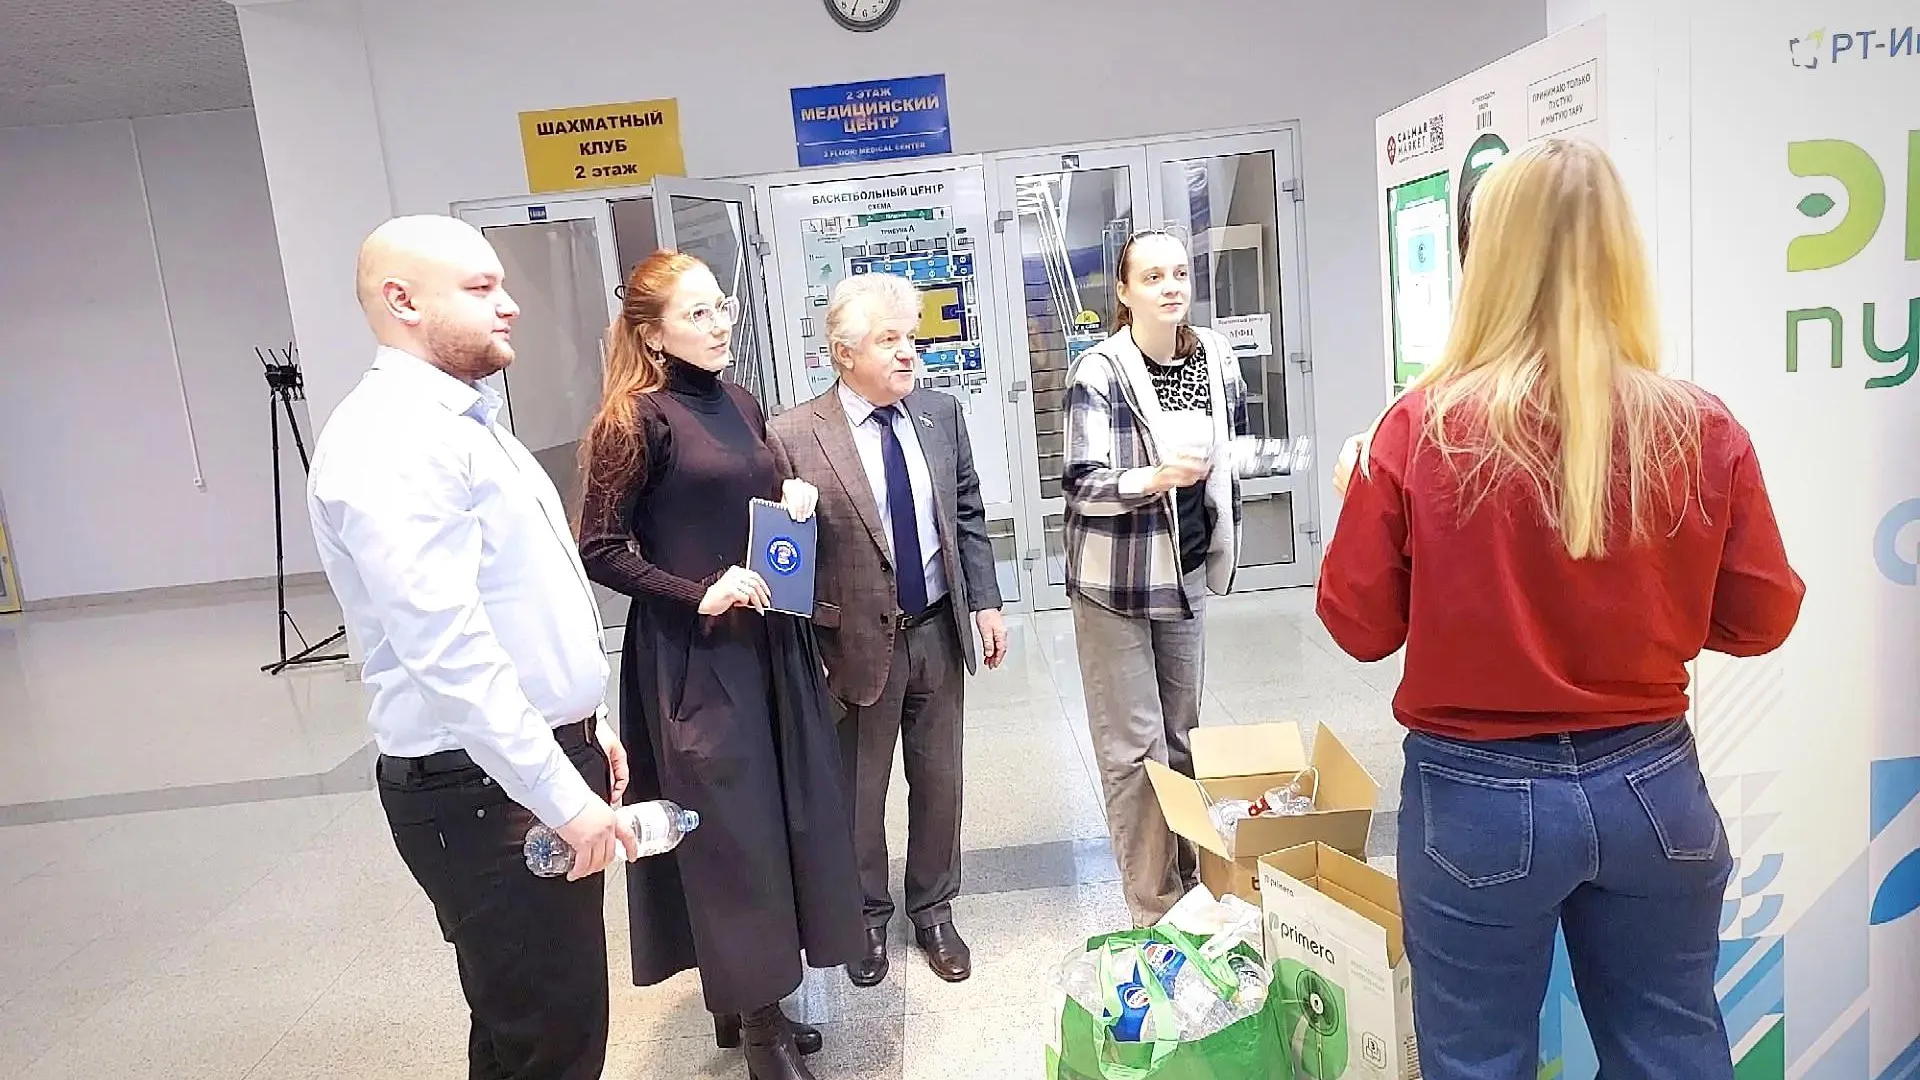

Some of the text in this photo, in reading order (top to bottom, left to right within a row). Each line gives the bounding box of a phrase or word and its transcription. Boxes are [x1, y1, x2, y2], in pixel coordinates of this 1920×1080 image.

[1832, 26, 1920, 63] РТ-И
[845, 87, 892, 100] 2 ЭТАЖ
[1532, 73, 1591, 103] ПРИНИМАЮ ТОЛЬКО
[801, 93, 940, 121] МЕДИЦИНСКИЙ
[1548, 94, 1573, 109] ПУСТУЮ
[1568, 104, 1583, 117] ТАРУ
[537, 109, 664, 136] ШАХМАТНЫЙ
[843, 115, 900, 134] ЦЕНТР
[1397, 122, 1428, 143] CALMAR
[579, 139, 627, 156] КЛУБ
[859, 146, 893, 155] MEDICAL
[895, 142, 926, 151] CENTER
[1397, 136, 1426, 156] MARKET
[574, 164, 638, 179] 2 этаж
[812, 183, 945, 205] БАСКЕТБОЛЬНЫЙ ЦЕНТР
[867, 202, 892, 211] СХЕМА
[881, 227, 907, 235] ТРИБУНА
[1281, 922, 1335, 965] primera
